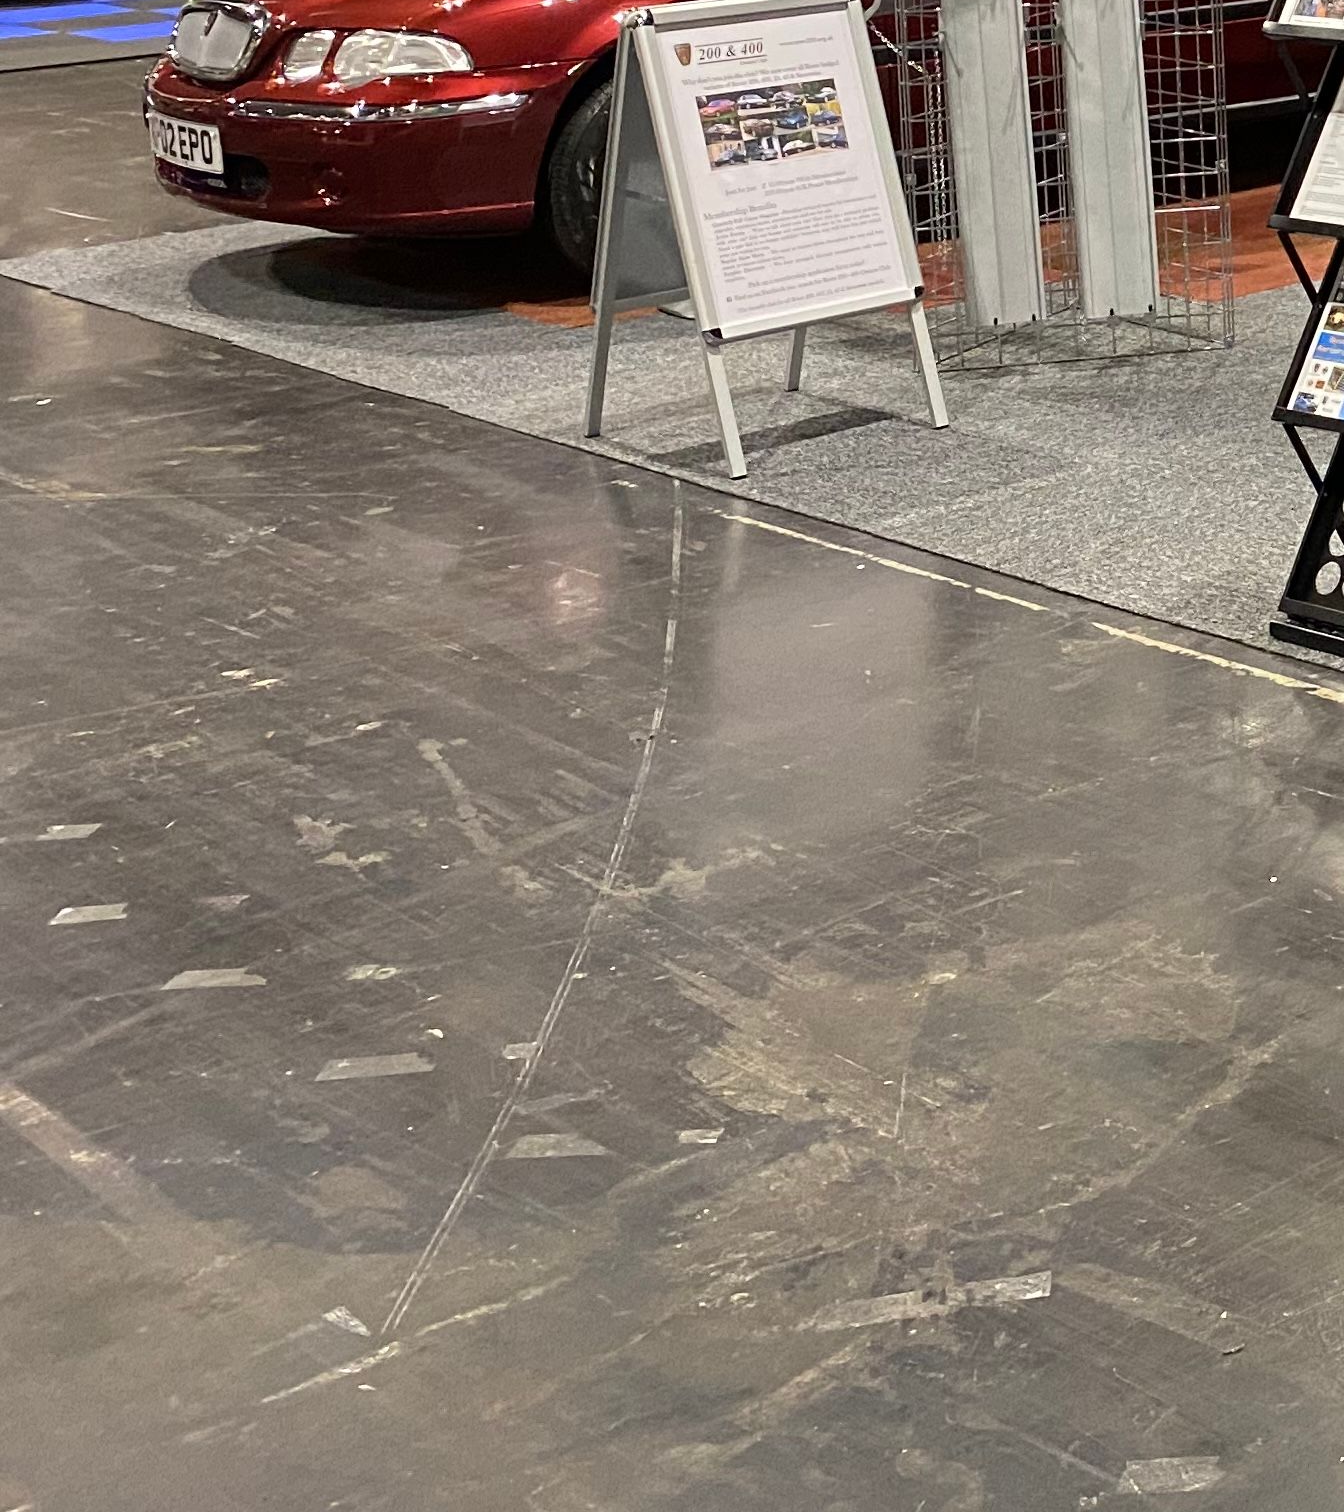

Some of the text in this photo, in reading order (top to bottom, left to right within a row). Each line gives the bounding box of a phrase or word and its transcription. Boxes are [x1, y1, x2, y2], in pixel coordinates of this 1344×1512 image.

[700, 47, 721, 61] 200
[727, 45, 736, 57] &
[741, 41, 764, 55] 400
